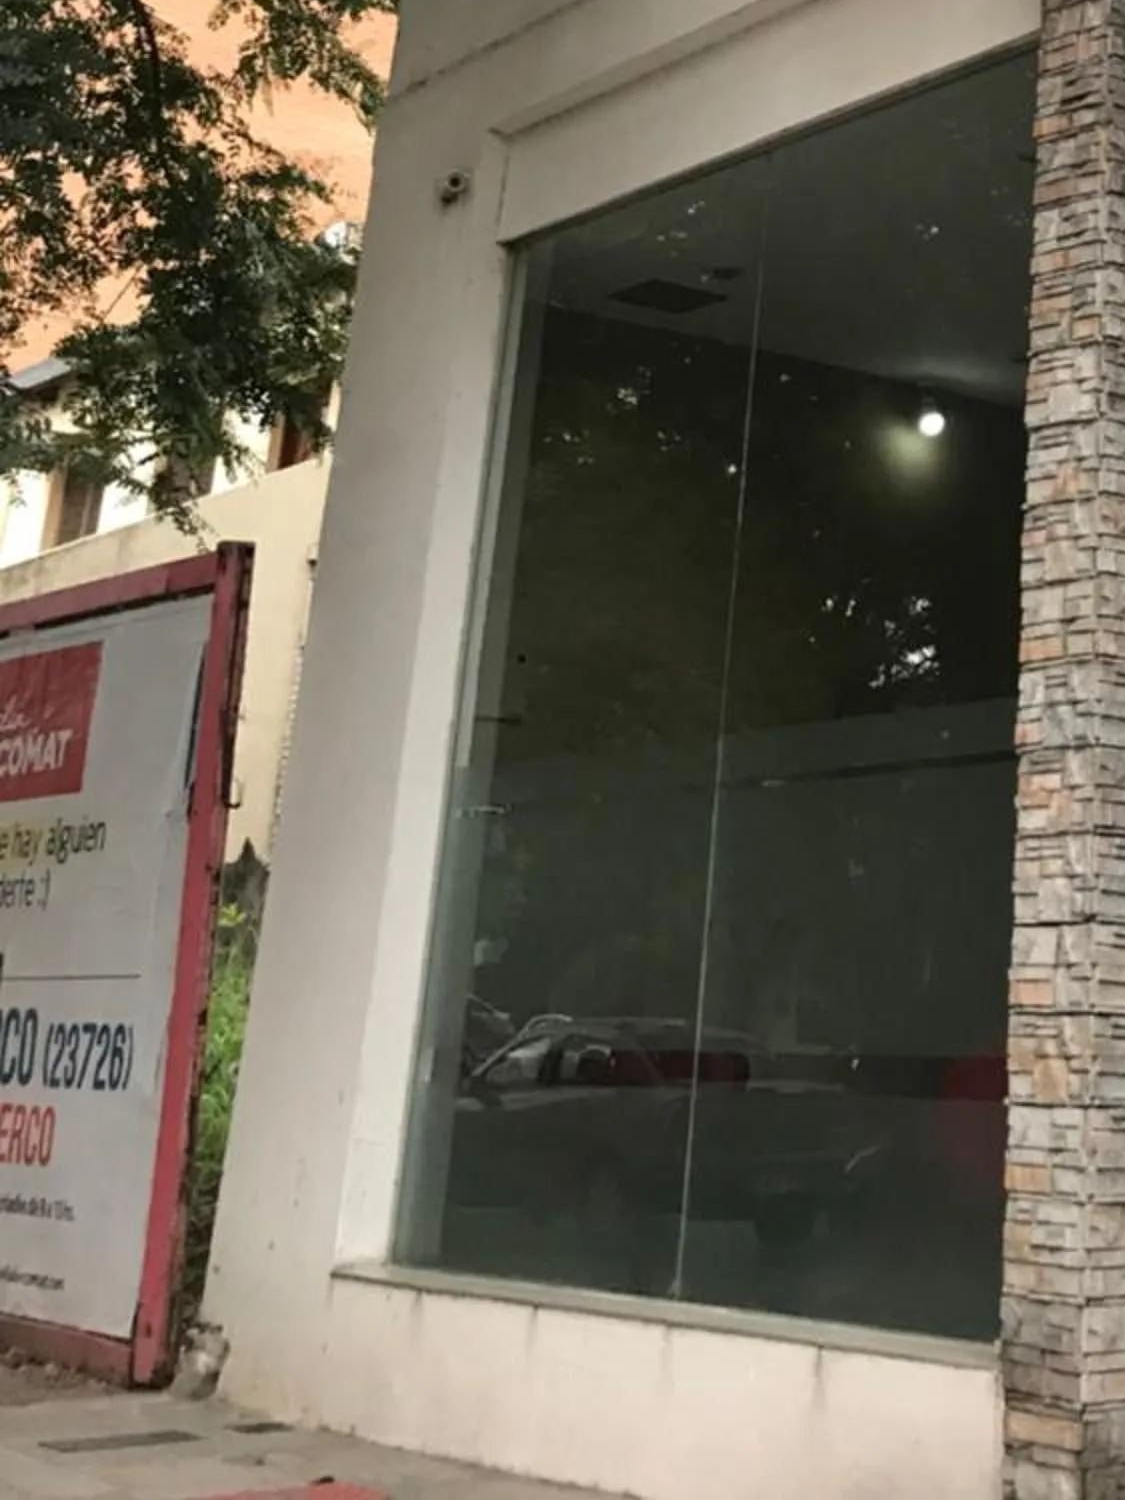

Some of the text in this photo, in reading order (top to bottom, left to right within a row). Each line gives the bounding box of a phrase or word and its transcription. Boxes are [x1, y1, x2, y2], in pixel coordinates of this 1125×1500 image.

[46, 815, 106, 866] alguien
[0, 1006, 134, 1092] CO (23726)
